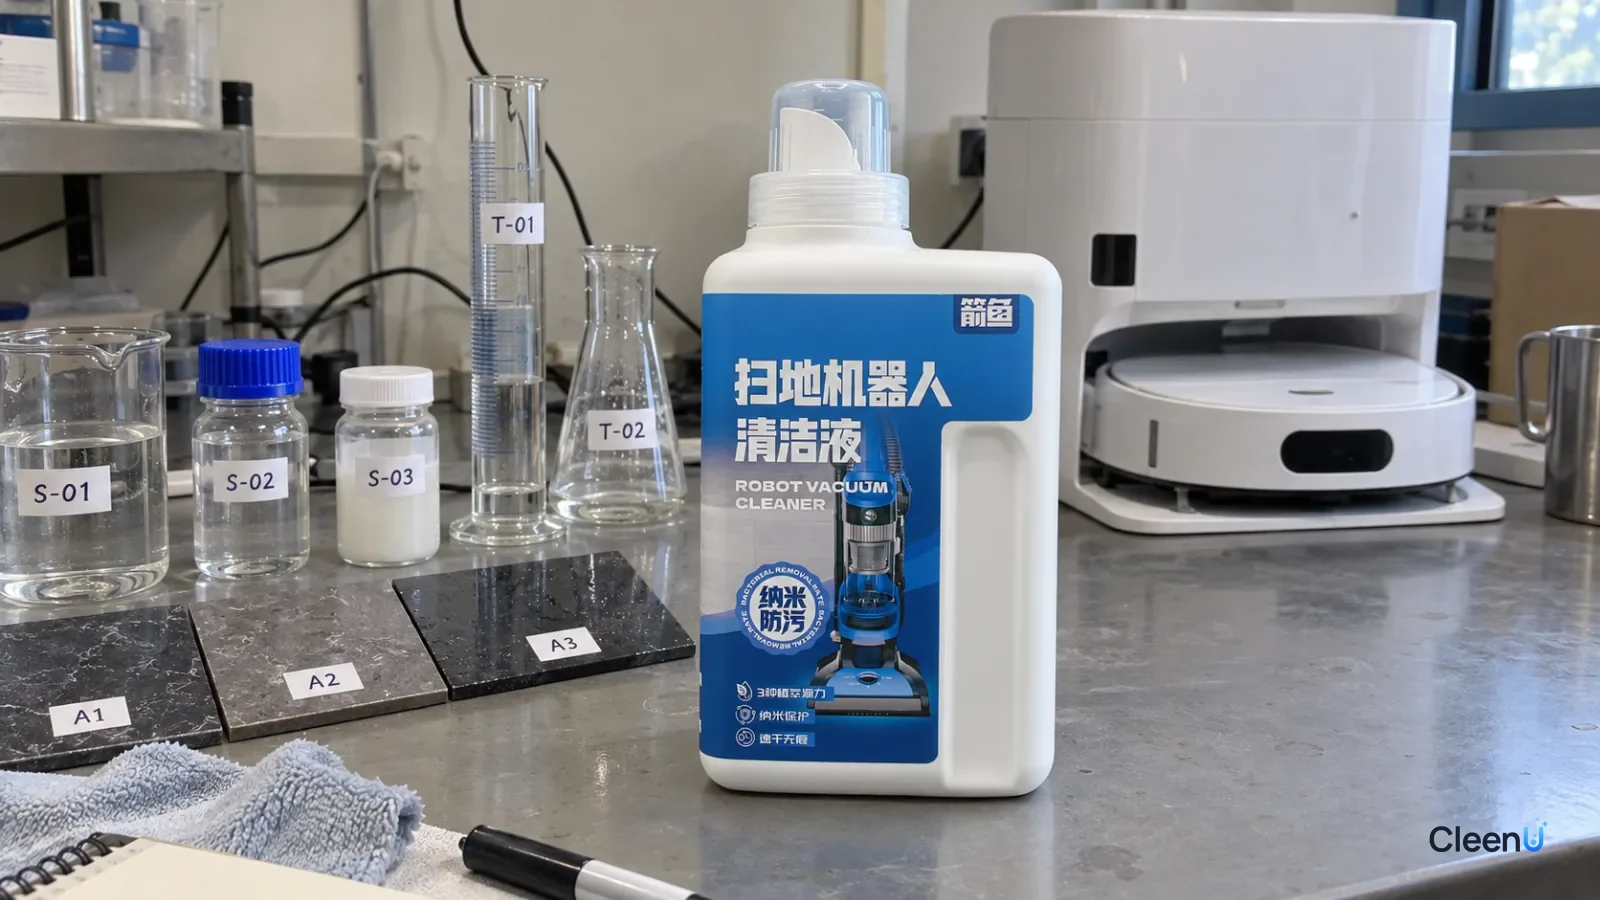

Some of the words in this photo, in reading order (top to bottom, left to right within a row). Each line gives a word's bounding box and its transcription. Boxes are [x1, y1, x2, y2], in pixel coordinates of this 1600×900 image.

[491, 216, 533, 233] T-01
[961, 298, 1013, 327] 箭鱼
[734, 358, 952, 407] 扫地机器人
[599, 421, 645, 440] T-02
[734, 417, 862, 464] 清洁液
[226, 472, 275, 491] S-02
[368, 468, 413, 487] S-03
[735, 480, 803, 493] ROBOT
[806, 481, 888, 493] VACUUM
[34, 482, 89, 503] S-01
[735, 497, 826, 510] CLEANER
[758, 586, 807, 609] 纳米
[760, 610, 806, 635] 防污
[550, 636, 578, 652] A3
[308, 671, 341, 690] A2
[73, 706, 105, 726] A1
[759, 710, 810, 722] 纳米保护
